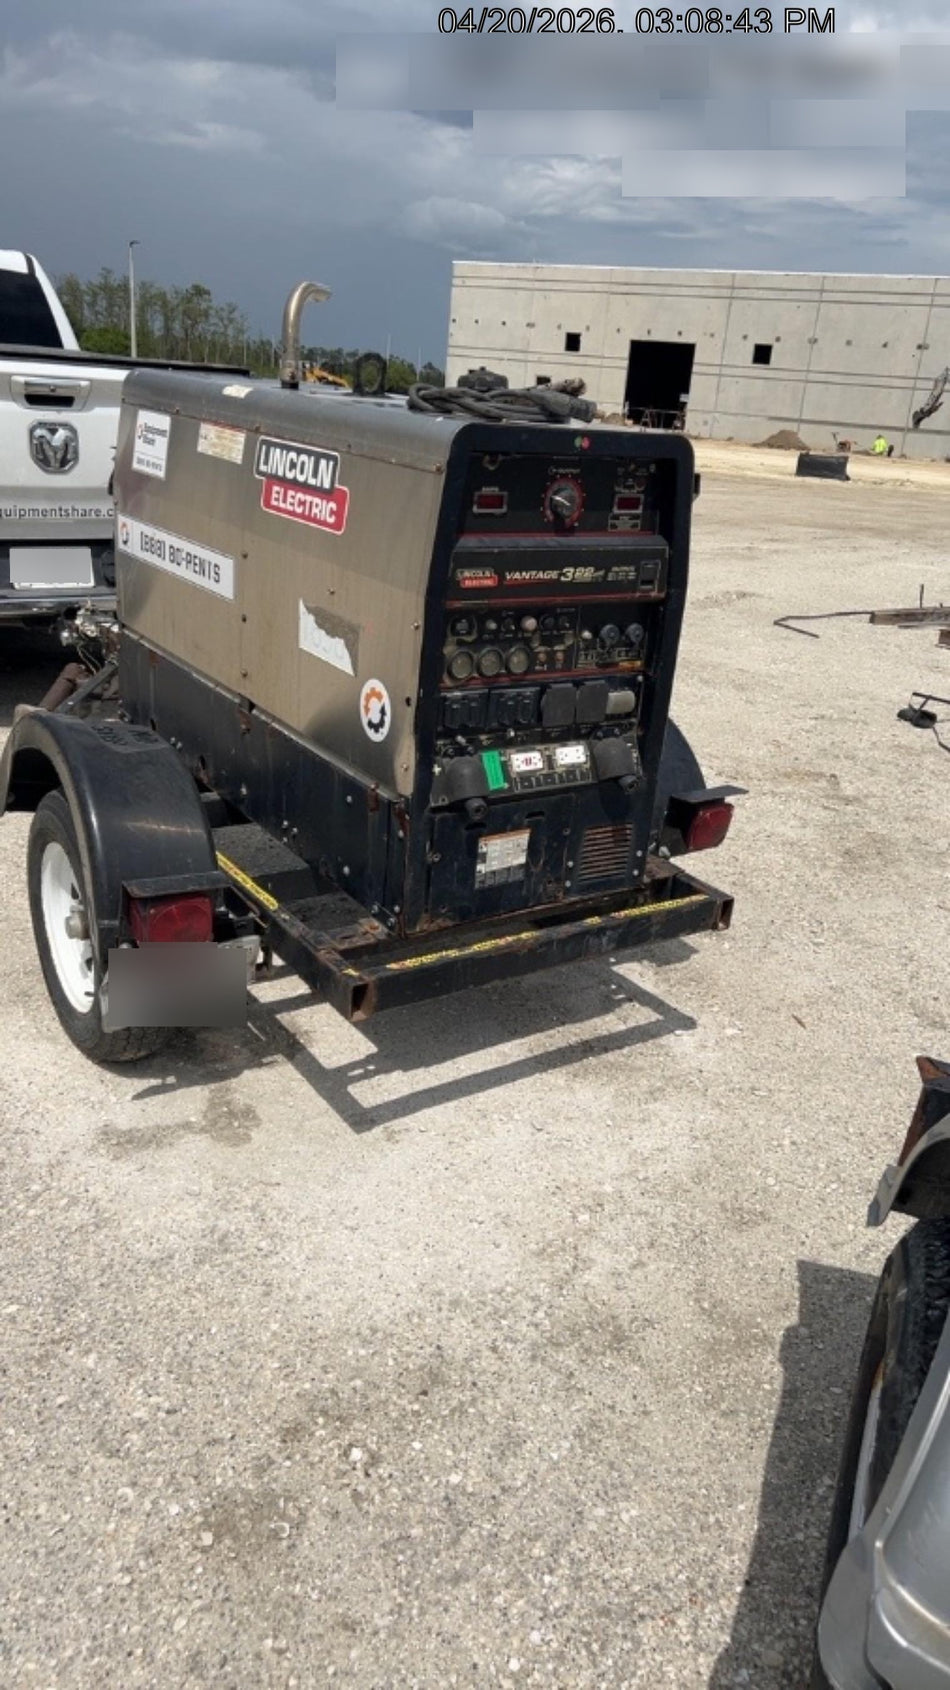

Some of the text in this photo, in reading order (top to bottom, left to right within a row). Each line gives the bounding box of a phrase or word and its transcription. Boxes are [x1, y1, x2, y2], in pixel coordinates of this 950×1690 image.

[259, 444, 334, 489] LINCOLN
[270, 485, 337, 523] ELECTRIC
[504, 570, 560, 580] VANTAGE
